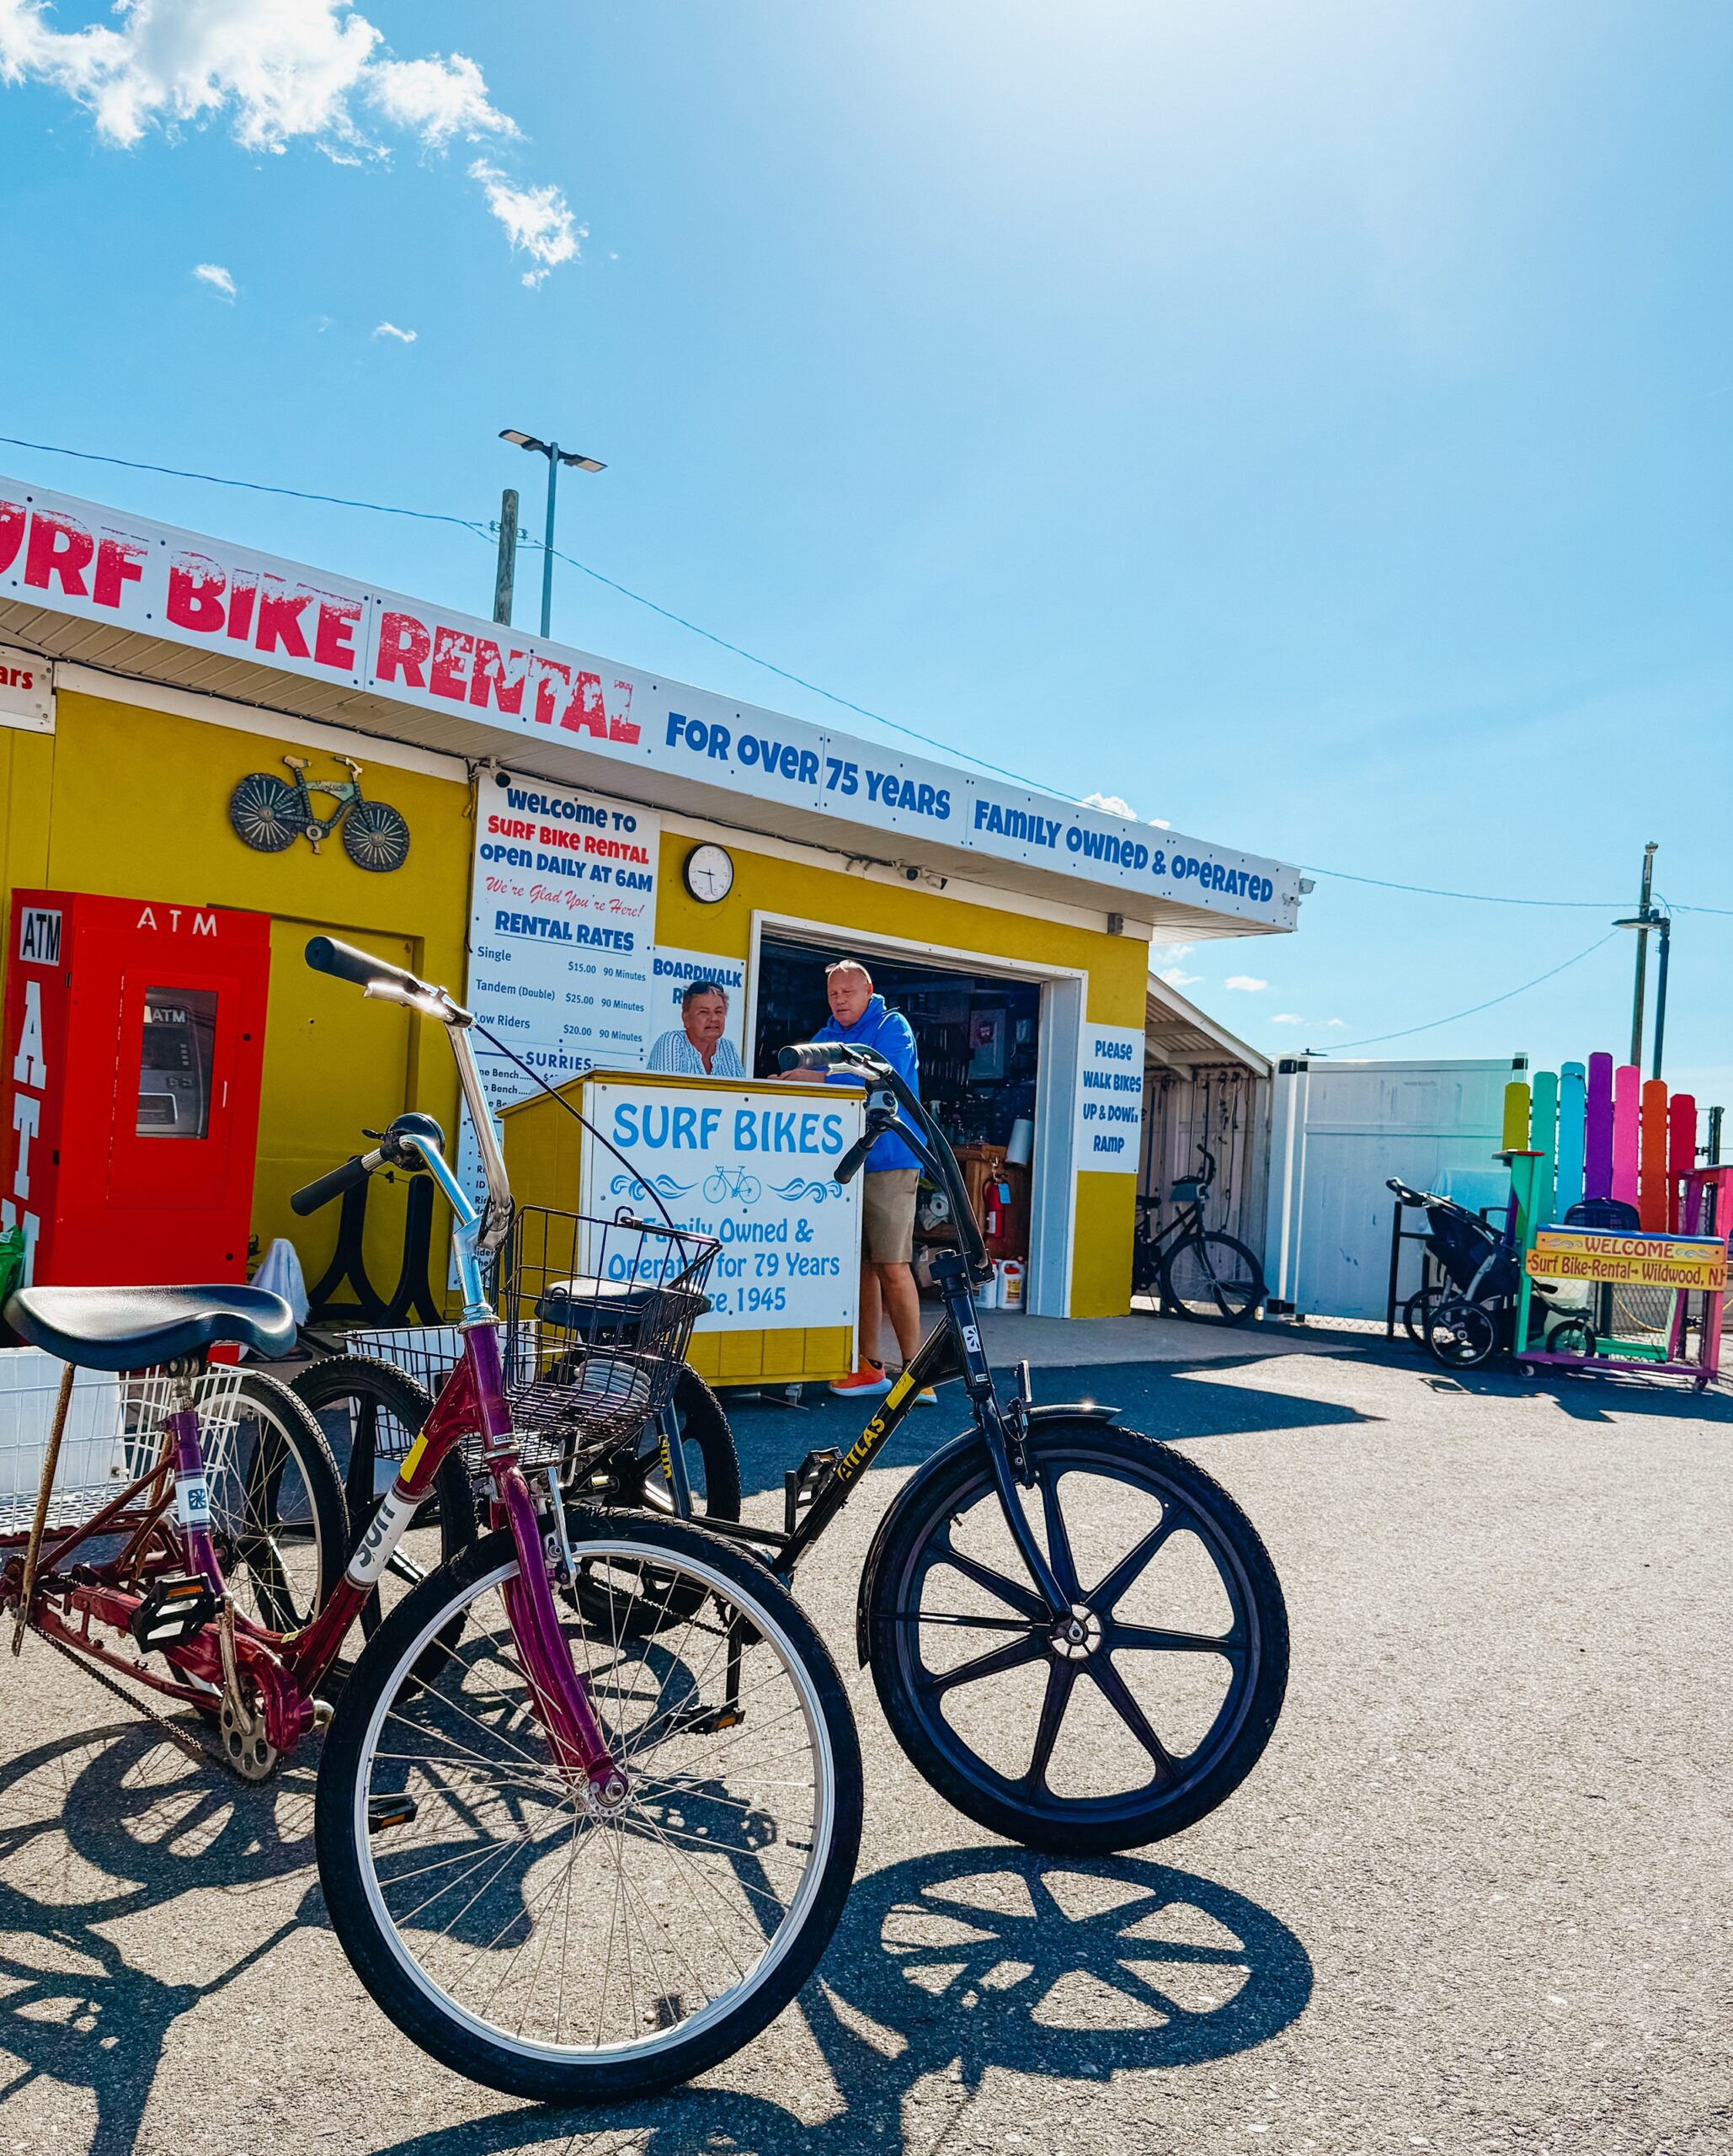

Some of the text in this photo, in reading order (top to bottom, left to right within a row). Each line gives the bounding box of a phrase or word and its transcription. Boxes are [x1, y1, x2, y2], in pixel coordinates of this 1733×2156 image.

[166, 551, 362, 671] BIKE
[376, 611, 642, 745] RENTAL
[665, 712, 730, 760] FOR
[824, 757, 858, 795] 75
[1151, 850, 1166, 875] &
[488, 814, 536, 841] SURF
[611, 813, 637, 833] TO
[536, 853, 586, 878] DAILY
[589, 864, 612, 883] AT
[616, 869, 653, 893] 6AM
[486, 876, 645, 918] We're Glad You're Here!
[22, 912, 61, 962] ATM
[137, 907, 218, 937] ATM
[495, 910, 634, 952] RENTAL RATES
[477, 946, 646, 982] Single $15.00 90 Minutes
[653, 958, 742, 988] BOARDWALK
[476, 979, 644, 1012] Tandem (Double) $25.00 90 Minutes
[152, 1009, 185, 1022] ATM
[474, 1011, 643, 1043] Low Riders $20.00 90 Minutes
[525, 1050, 592, 1070] SURRIES
[1083, 1070, 1112, 1090] WALK
[1083, 1103, 1097, 1120] UP
[1098, 1104, 1106, 1121] &
[612, 1102, 844, 1155] SURF BIKES
[719, 1218, 787, 1243] Owned
[795, 1218, 814, 1243] &
[1585, 1236, 1674, 1259] WELCOME
[717, 1252, 747, 1278] for
[754, 1253, 779, 1277] 79
[786, 1252, 840, 1277] Years
[1642, 1262, 1704, 1286] Wildwood,
[737, 1287, 787, 1312] 1945
[836, 1415, 885, 1482] ATLAS
